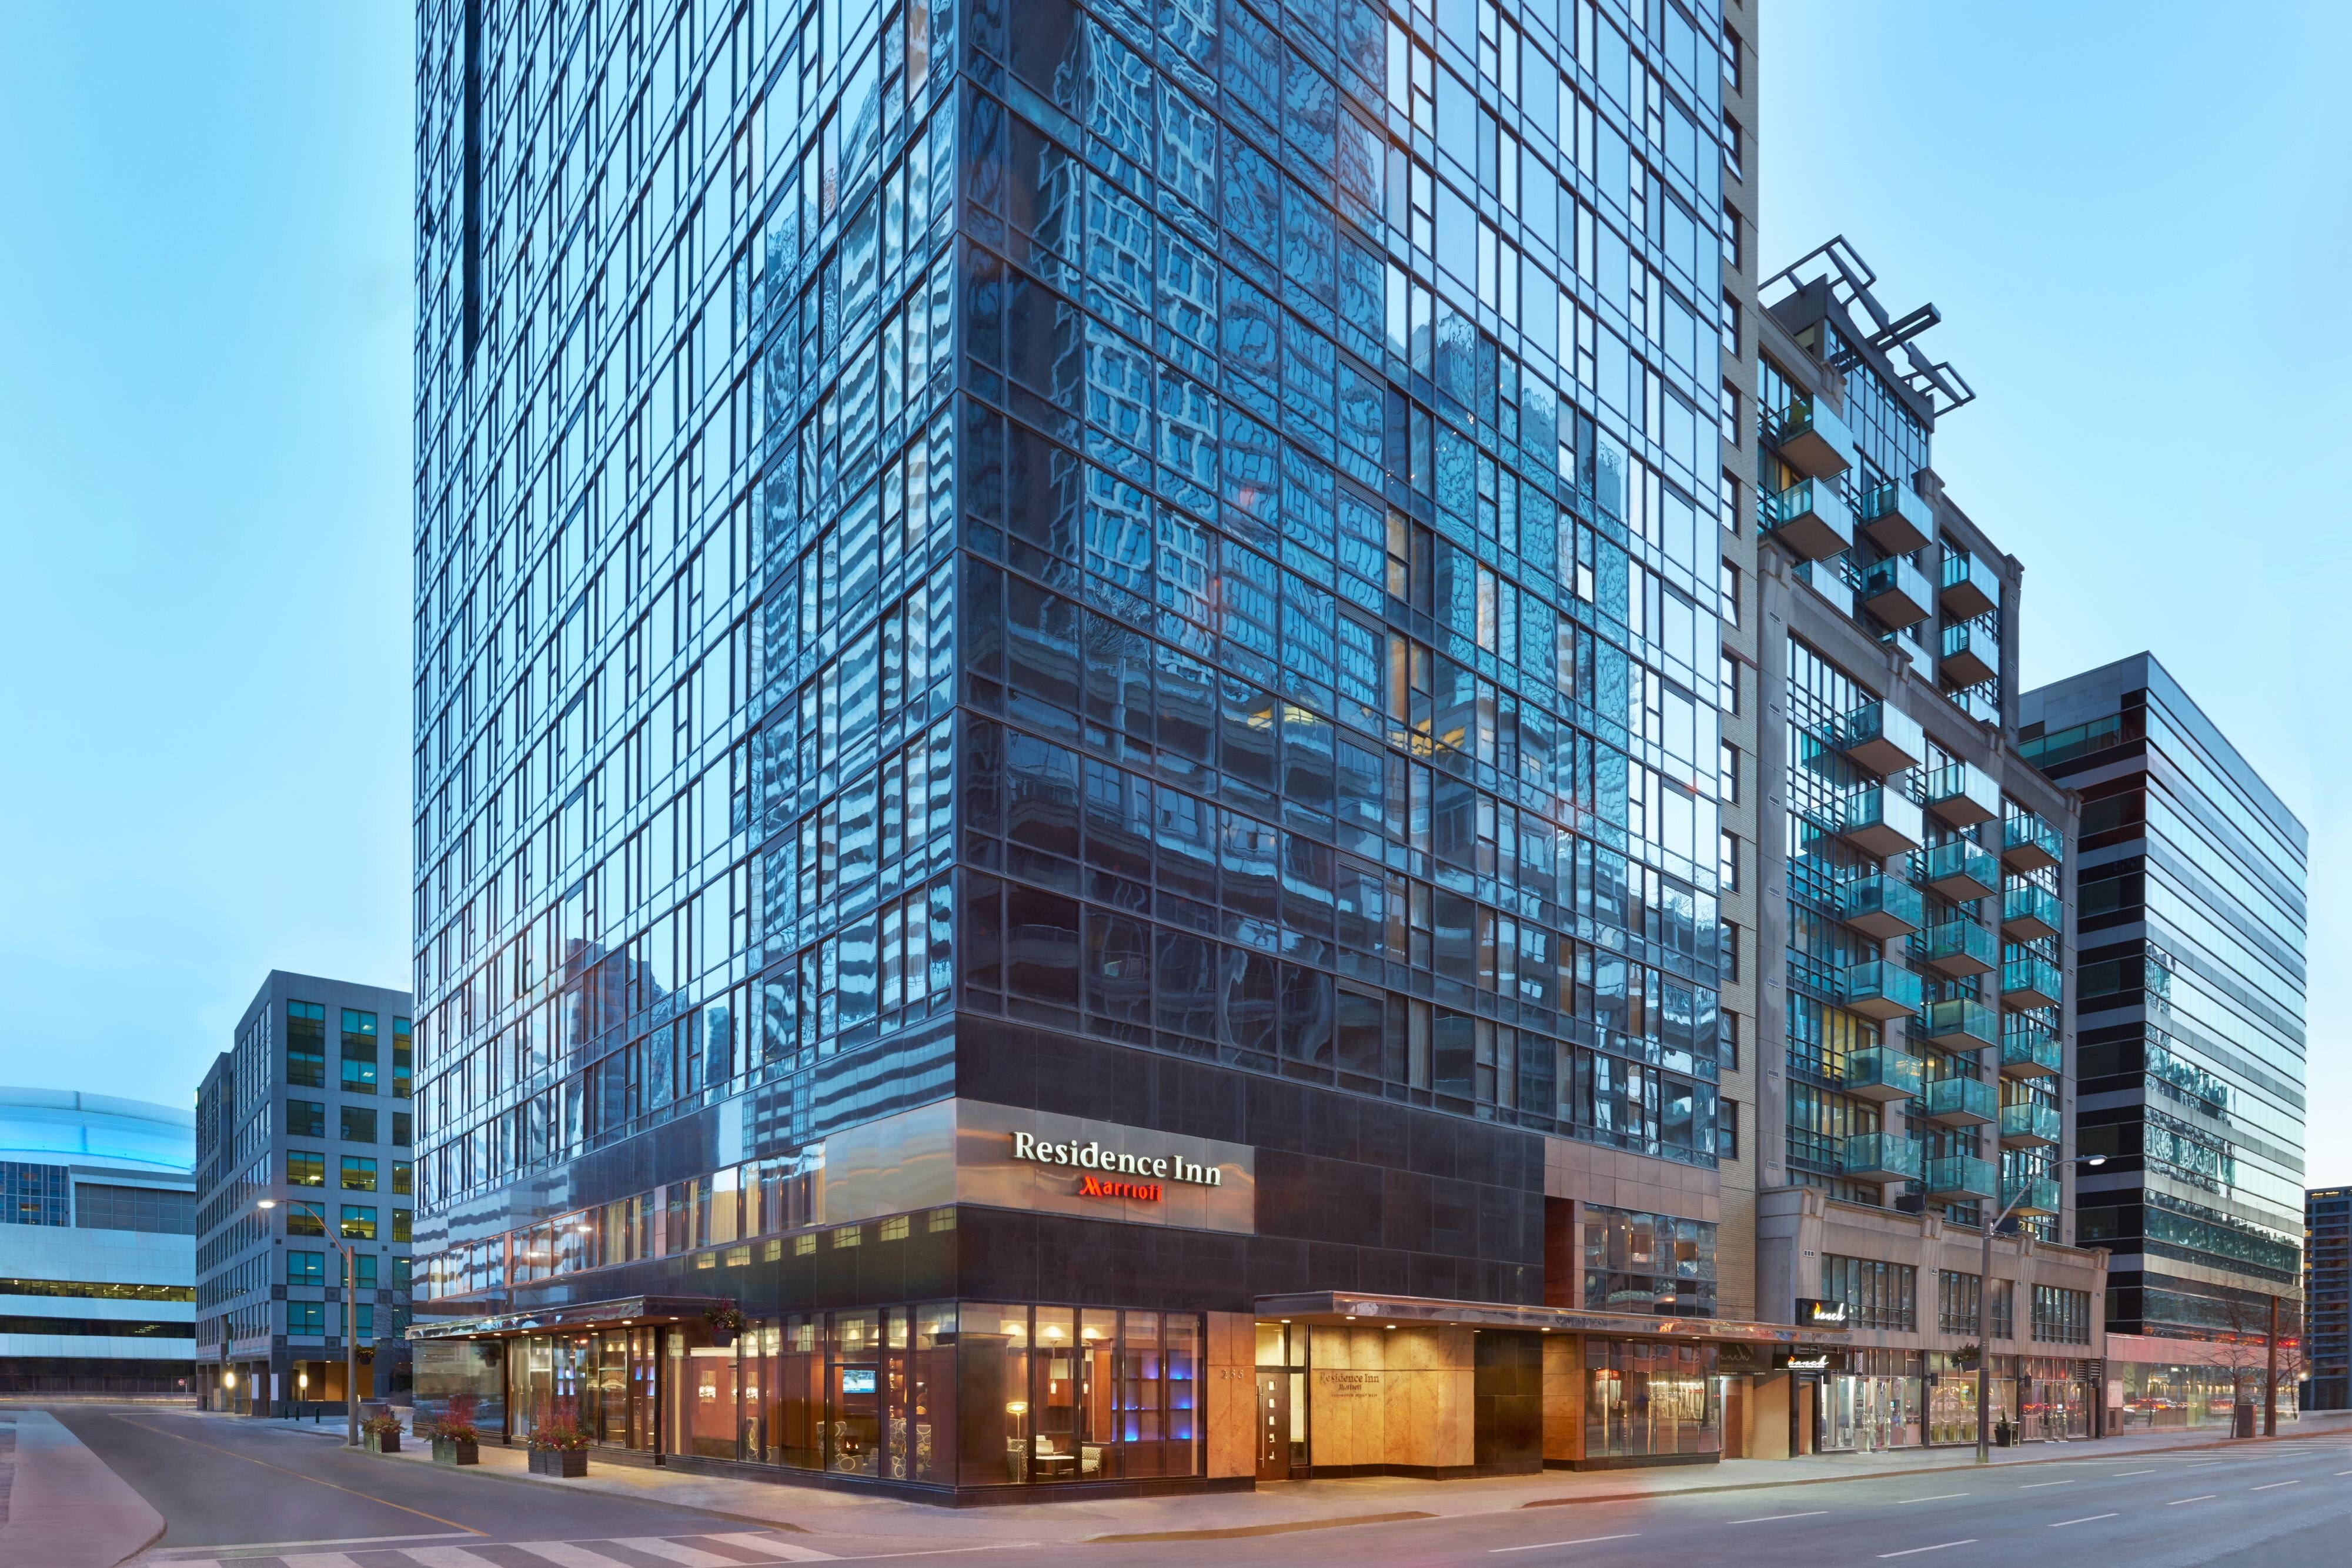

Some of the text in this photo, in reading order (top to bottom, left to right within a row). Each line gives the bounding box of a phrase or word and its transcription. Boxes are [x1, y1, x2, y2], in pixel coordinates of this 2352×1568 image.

[1013, 1131, 1221, 1186] Residence Inn
[1078, 1175, 1162, 1201] Marriott
[1319, 1372, 1379, 1384] Residence Inn
